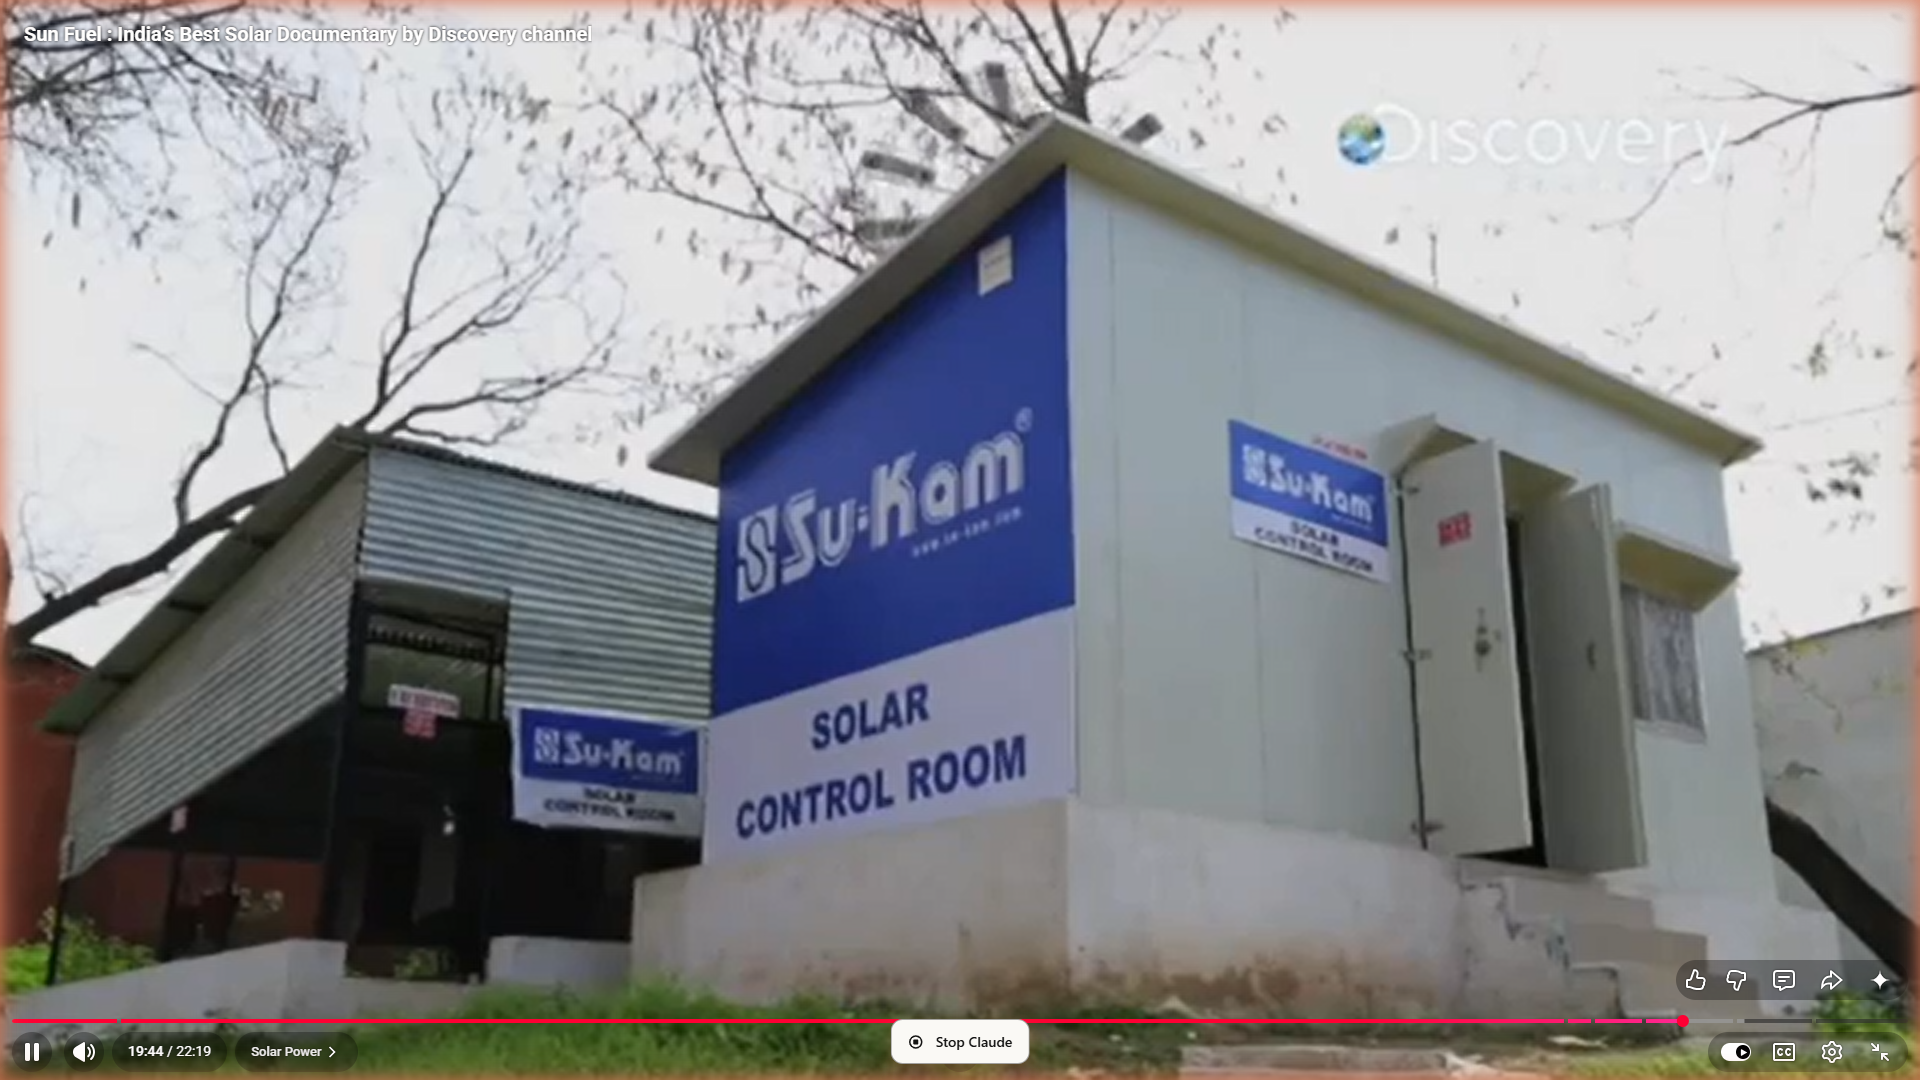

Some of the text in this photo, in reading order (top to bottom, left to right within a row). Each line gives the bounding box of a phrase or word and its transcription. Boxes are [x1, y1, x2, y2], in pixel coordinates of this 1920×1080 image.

[811, 682, 930, 750] SOLAR
[736, 734, 1027, 839] CONTROL ROOM
